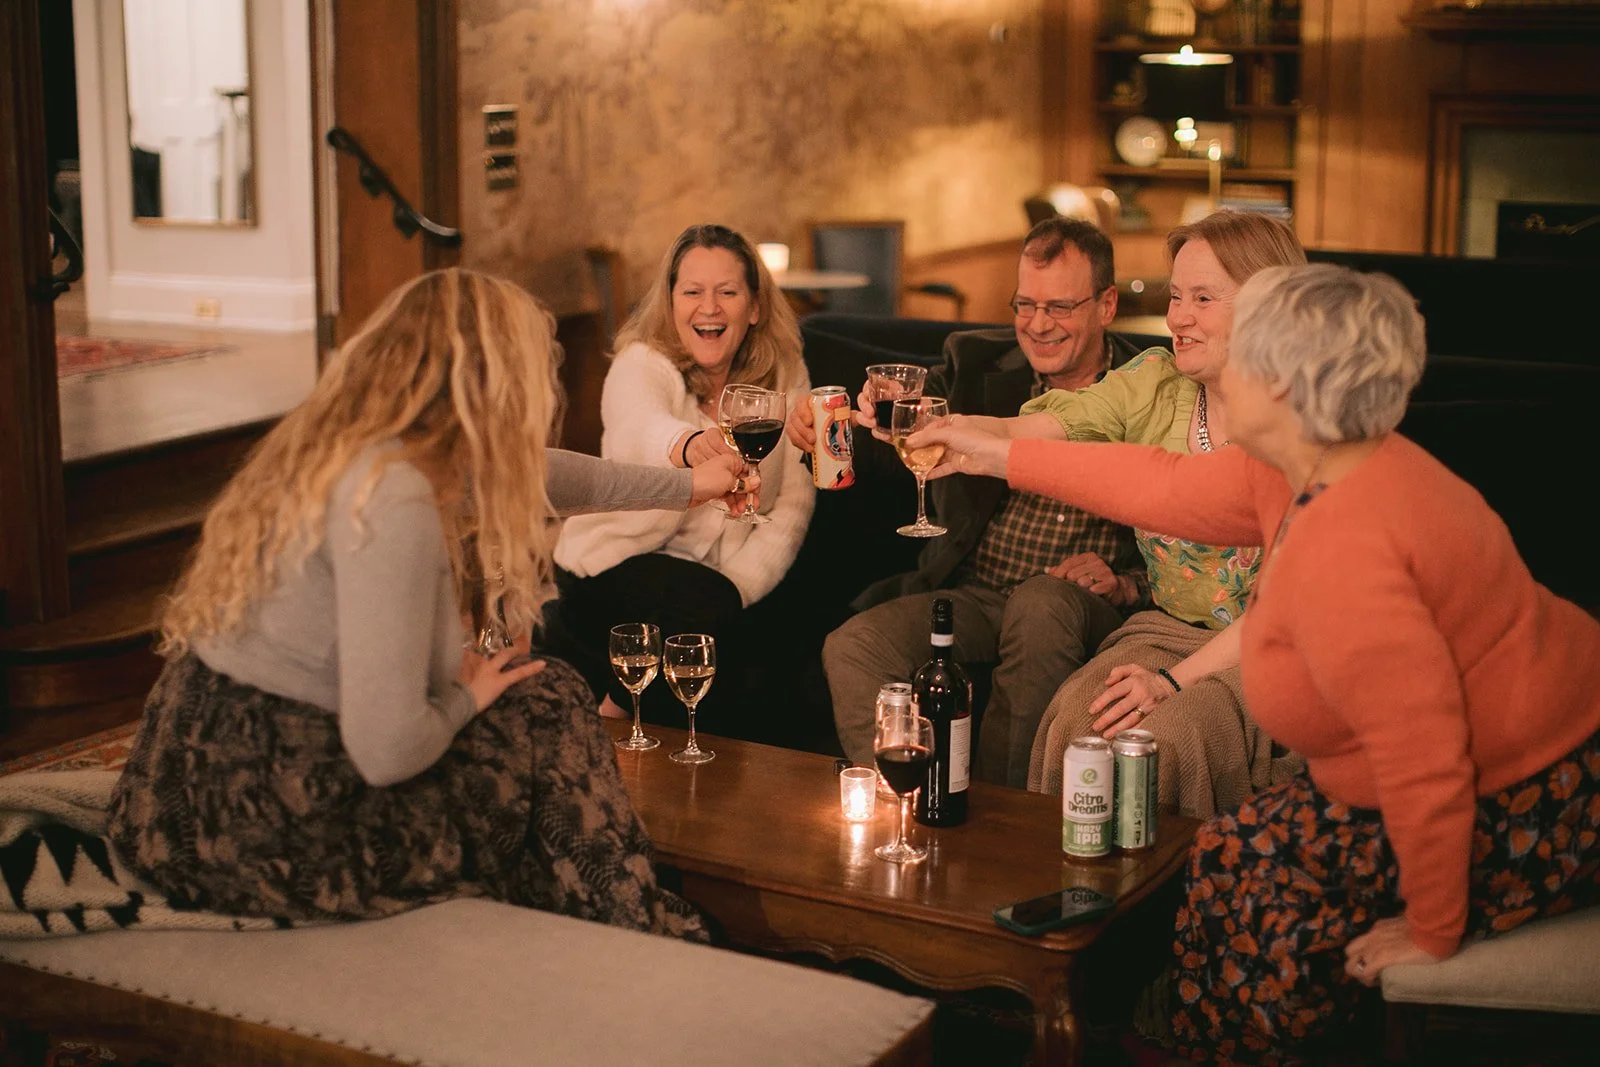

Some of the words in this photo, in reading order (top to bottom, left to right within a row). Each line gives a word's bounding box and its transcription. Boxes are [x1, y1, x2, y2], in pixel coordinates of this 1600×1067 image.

[1073, 791, 1104, 806] Citra
[1069, 800, 1109, 815] Dreams
[1075, 823, 1102, 834] HAZY
[1074, 833, 1102, 846] IPA
